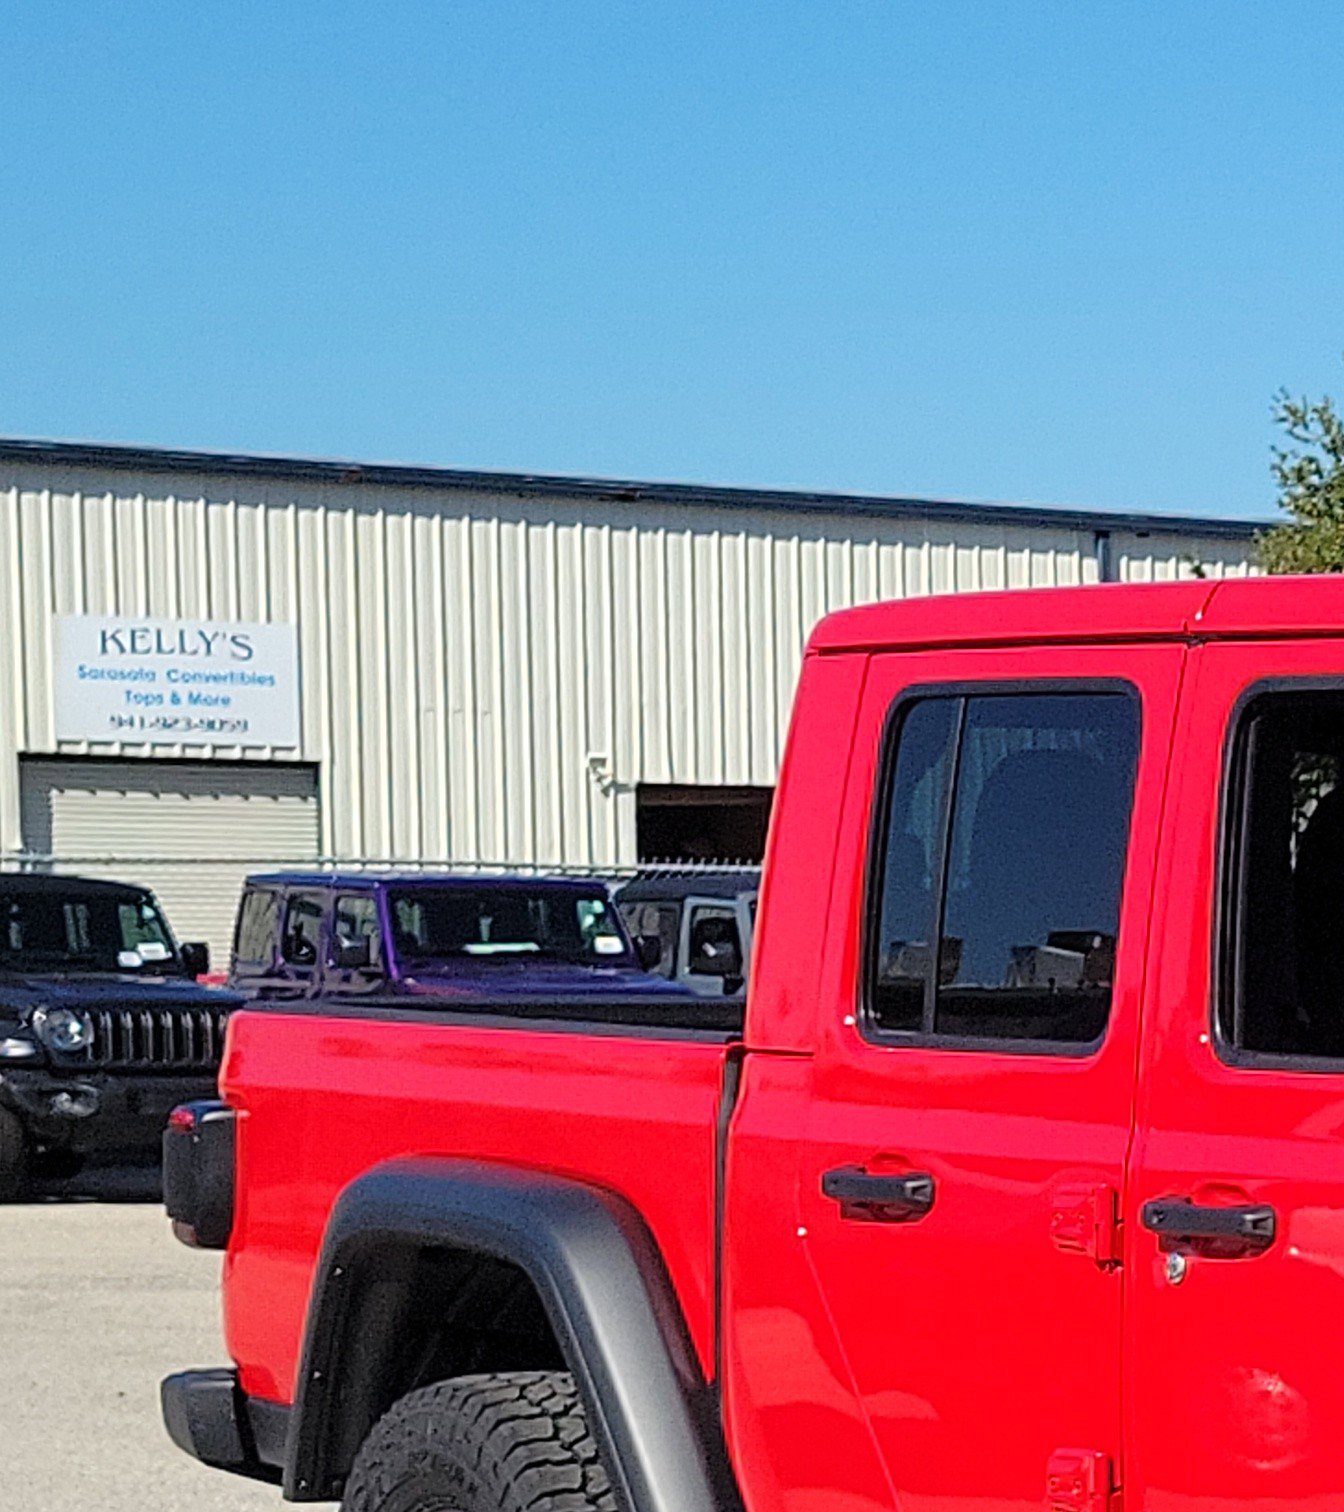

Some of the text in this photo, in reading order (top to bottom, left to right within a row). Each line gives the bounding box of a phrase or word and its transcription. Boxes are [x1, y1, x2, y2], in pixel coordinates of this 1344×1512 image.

[99, 627, 254, 662] KELLY'S
[77, 664, 276, 688] Sarasota Convertibles
[124, 689, 232, 707] Tops & More
